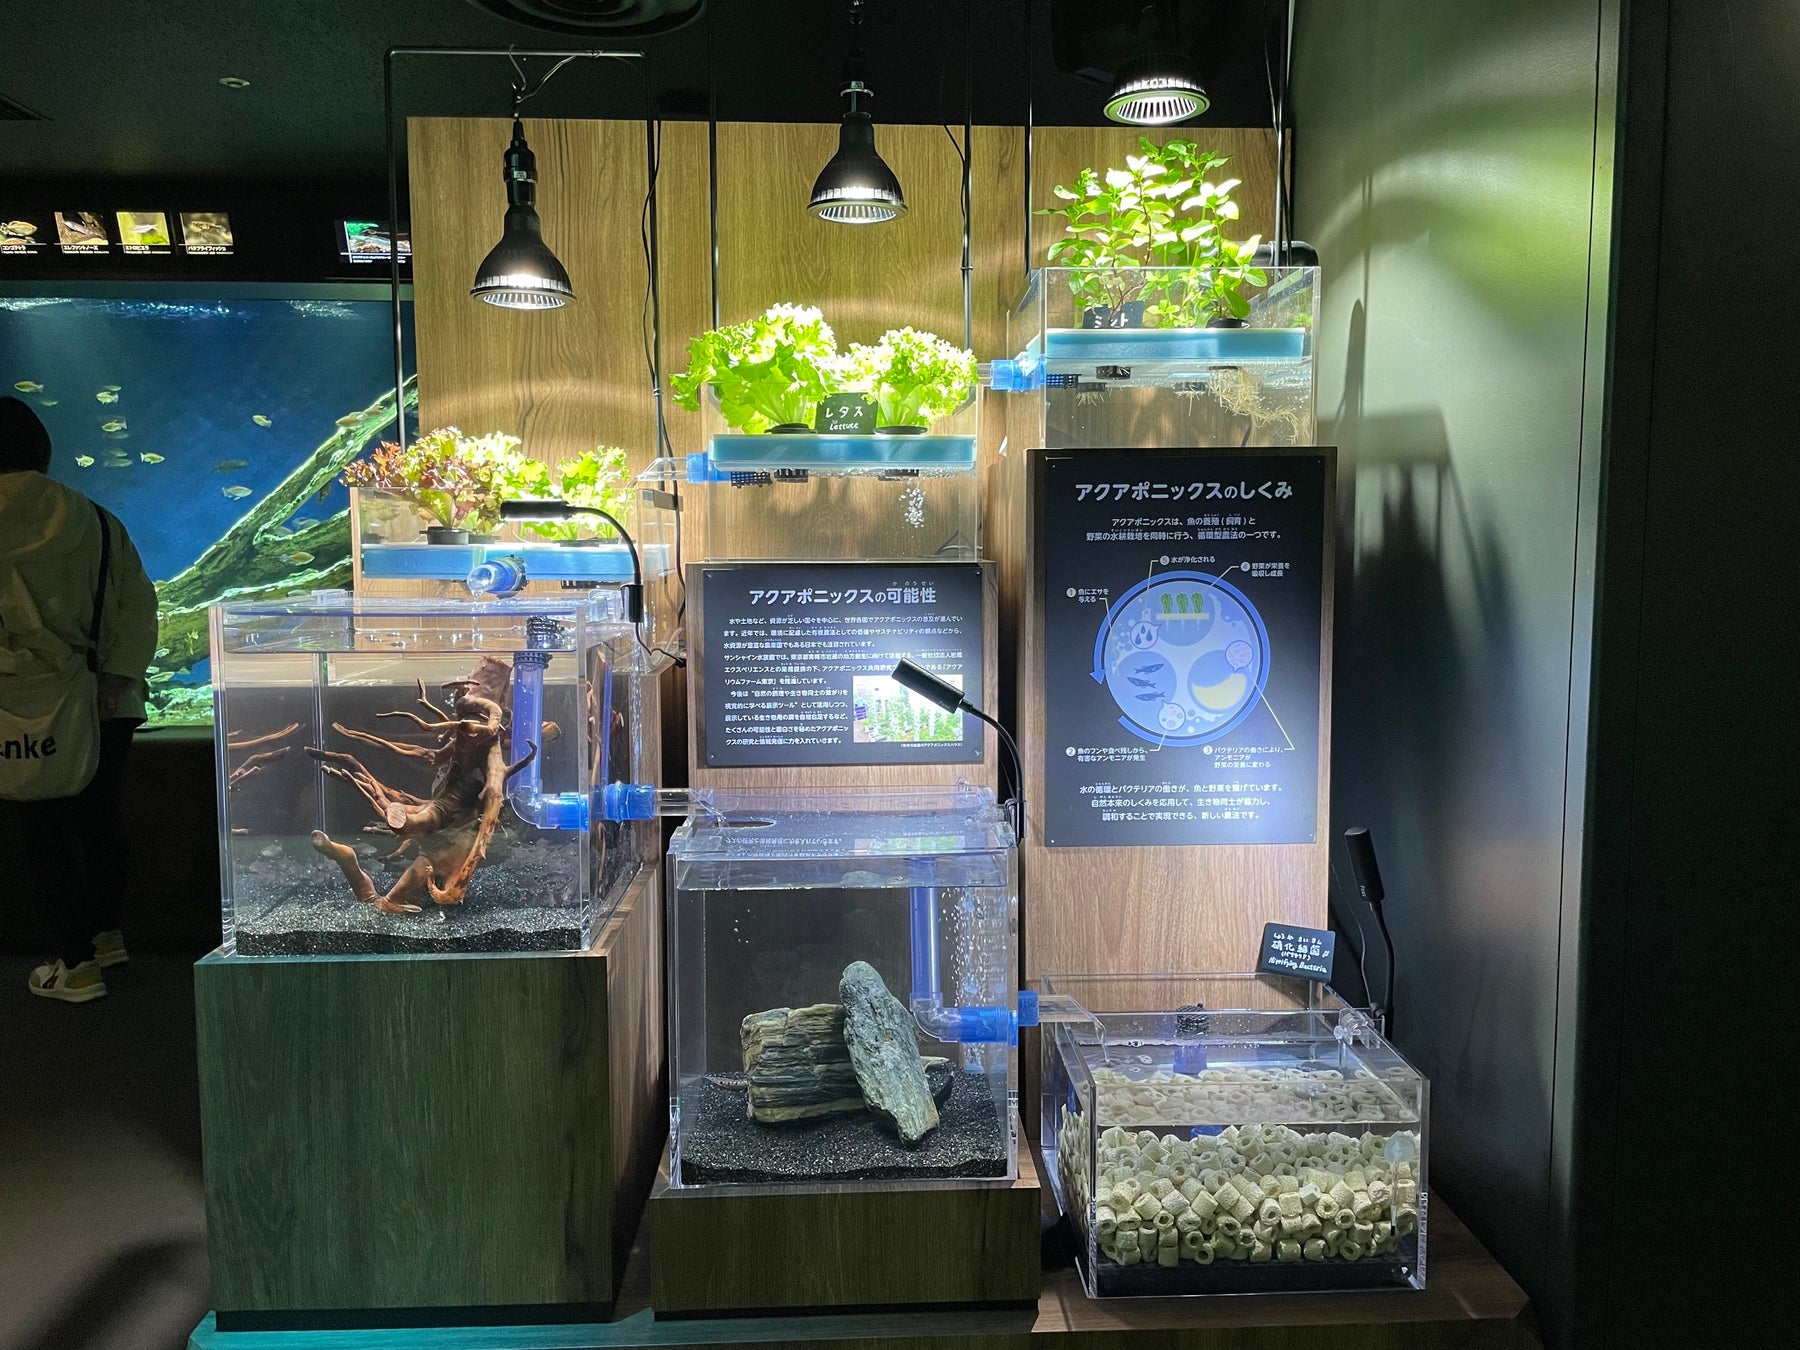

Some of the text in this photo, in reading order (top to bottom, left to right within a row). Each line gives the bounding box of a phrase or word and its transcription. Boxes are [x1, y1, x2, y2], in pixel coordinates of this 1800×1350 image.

[1094, 312, 1129, 329] ミント
[825, 406, 863, 419] レタス
[829, 422, 859, 431] Lettuce
[1075, 481, 1293, 501] アクアポニックスのしくみ
[1171, 556, 1215, 564] 水が浄化される
[749, 587, 936, 605] アクアポニックスの可能性
[0, 733, 57, 760] nke
[1102, 811, 1259, 821] 調和することで実現できる、新しい農法です。
